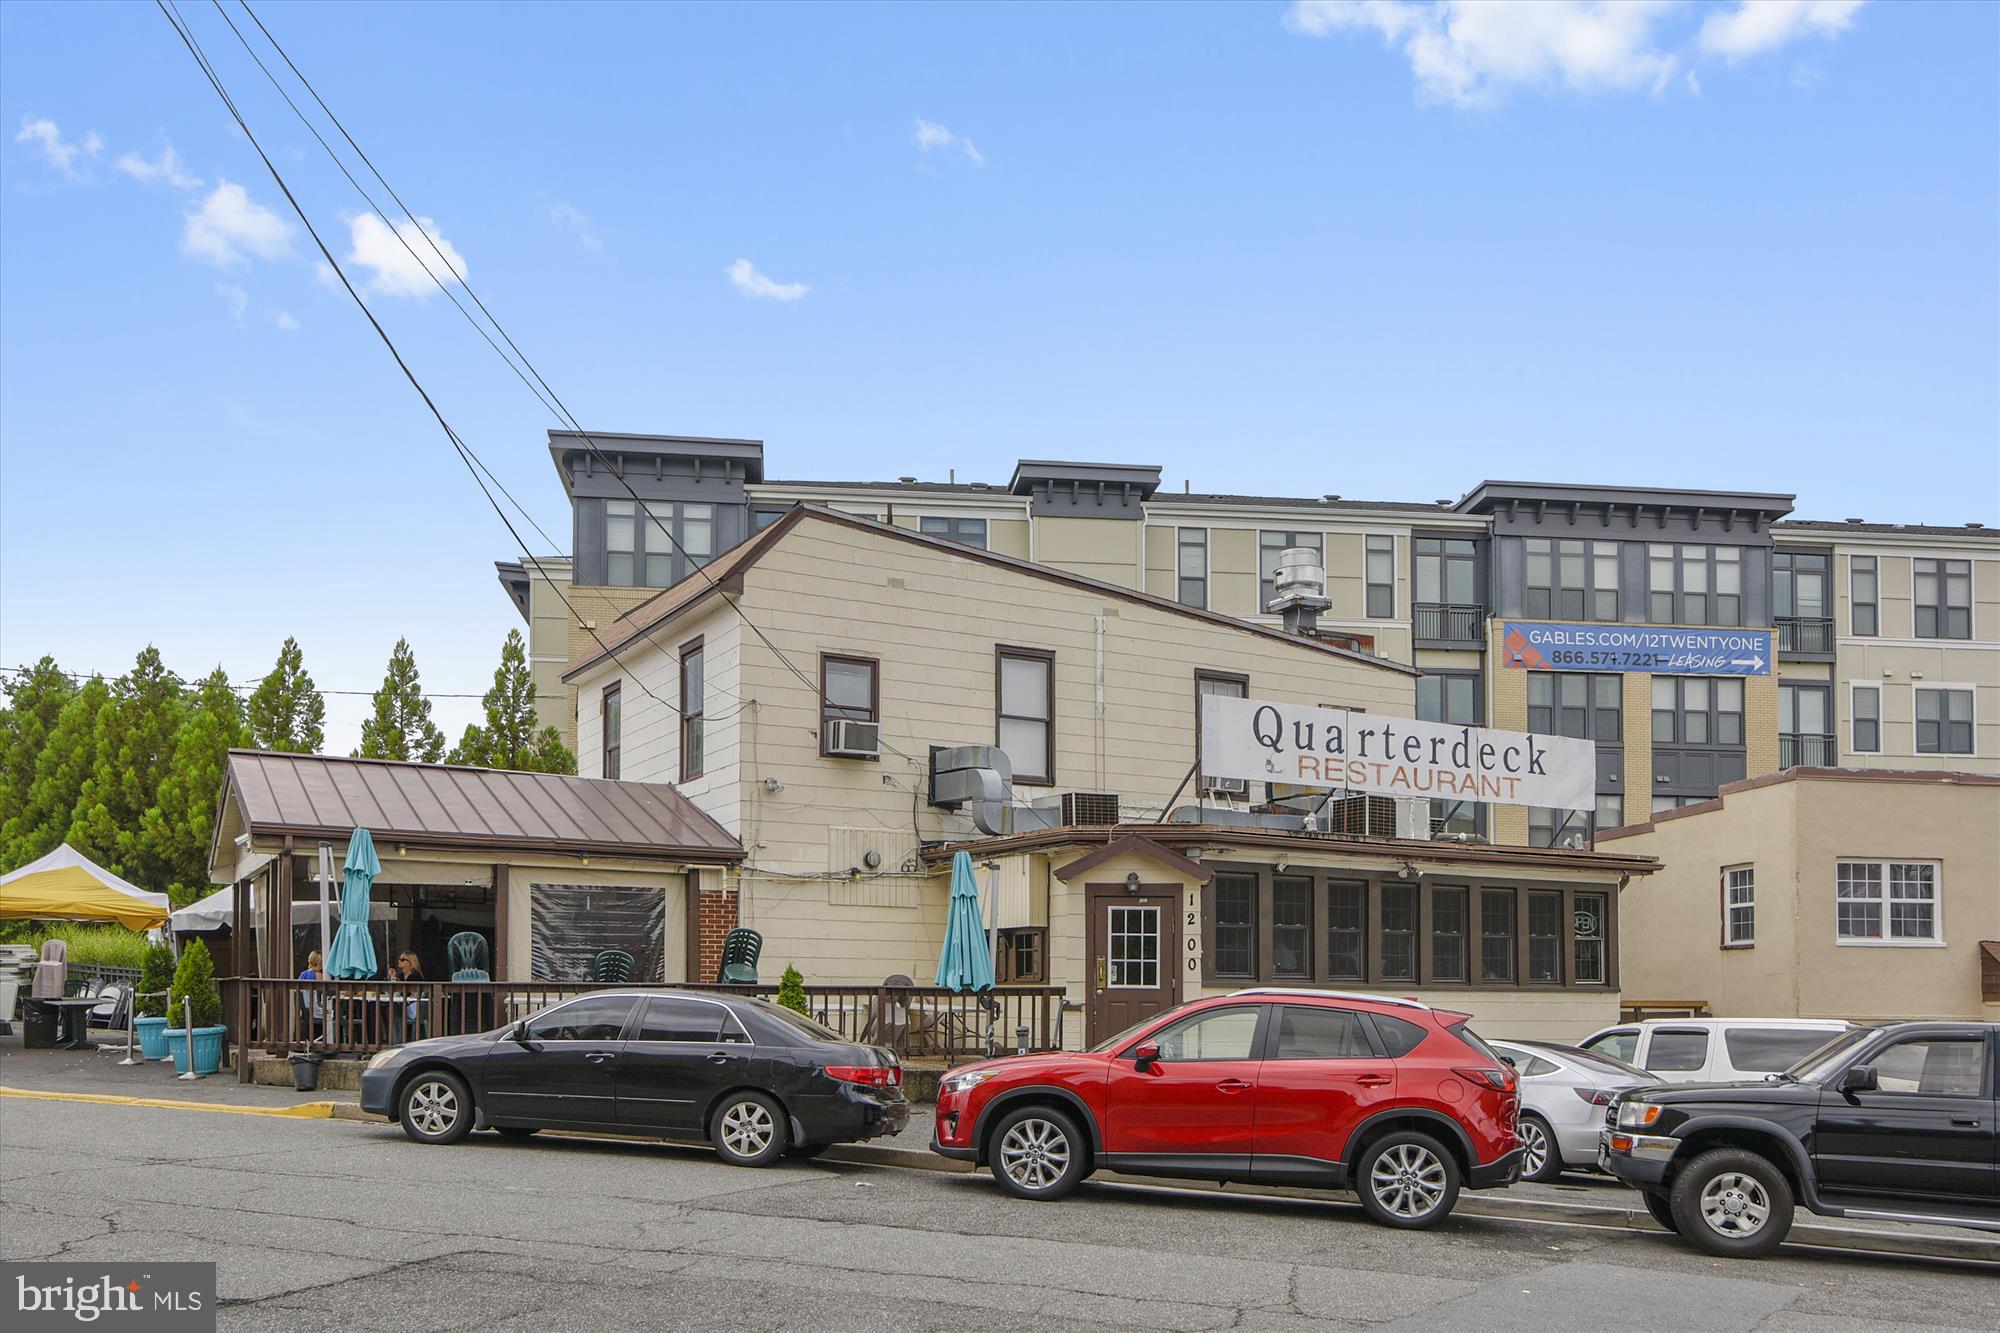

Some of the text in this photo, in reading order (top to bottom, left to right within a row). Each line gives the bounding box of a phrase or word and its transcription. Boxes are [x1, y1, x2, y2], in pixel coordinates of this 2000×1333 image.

[1529, 630, 1764, 651] GABLES.COM/12TWENTYONE
[1551, 650, 1728, 670] 866.571.7221 LEASING
[1252, 704, 1547, 776] Quarterdeck
[1297, 754, 1522, 800] RESTAURANT
